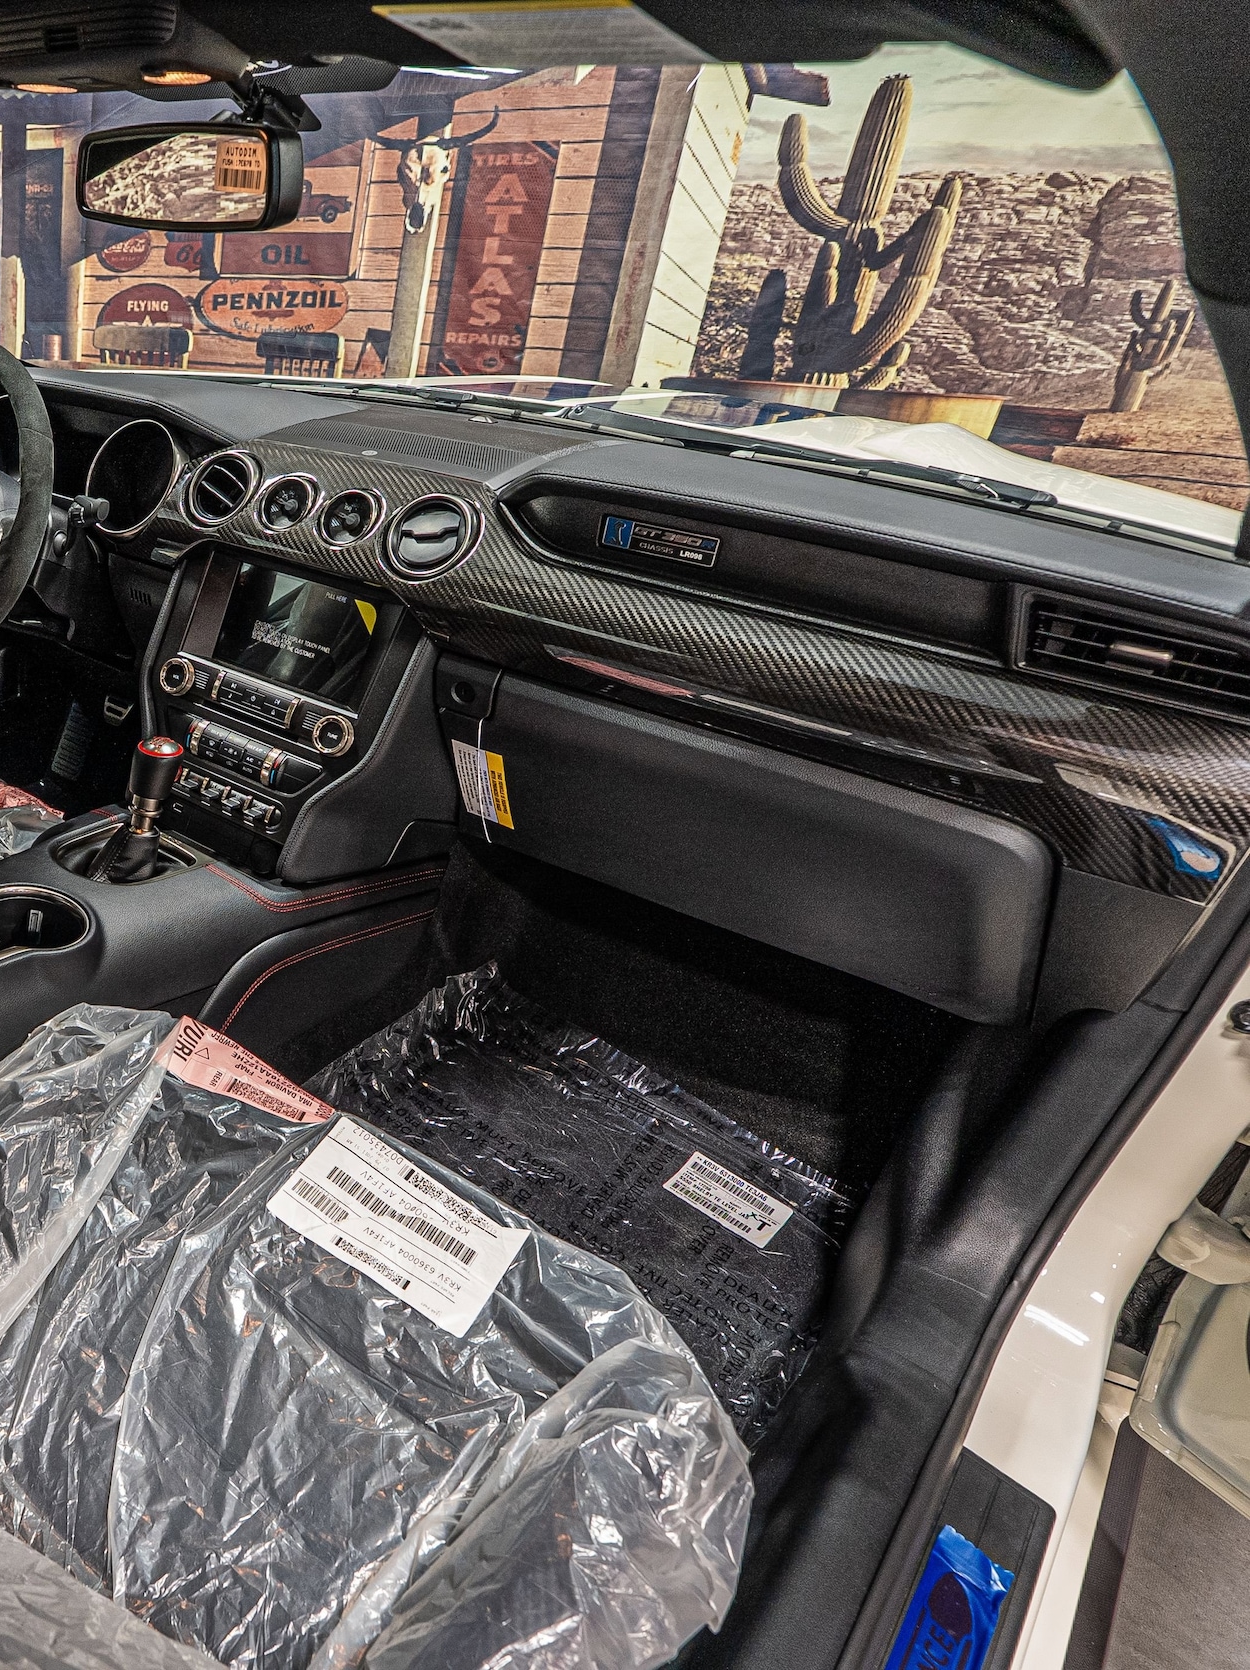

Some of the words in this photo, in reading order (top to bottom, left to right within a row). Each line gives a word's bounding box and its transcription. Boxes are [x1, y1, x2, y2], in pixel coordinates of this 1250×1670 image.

[226, 147, 257, 157] AUTODIM
[473, 153, 540, 166] TIRES
[261, 244, 310, 266] OIL
[468, 173, 529, 327] ATLAS
[126, 300, 169, 312] FLYING
[212, 289, 343, 311] PENNZOIL
[445, 332, 522, 347] REPAIRS
[639, 542, 674, 554] CHASSIS
[234, 1063, 255, 1076] FRAP
[209, 1071, 223, 1087] REAR
[265, 1079, 297, 1100] DAVISON
[299, 1096, 313, 1107] IMA
[702, 1160, 720, 1172] KR3V
[693, 1183, 713, 1198] SHELBY
[722, 1200, 737, 1213] LEVEL
[363, 1227, 395, 1249] AF1F4V
[397, 1247, 435, 1276] 6360004
[437, 1272, 462, 1292] KR3V
